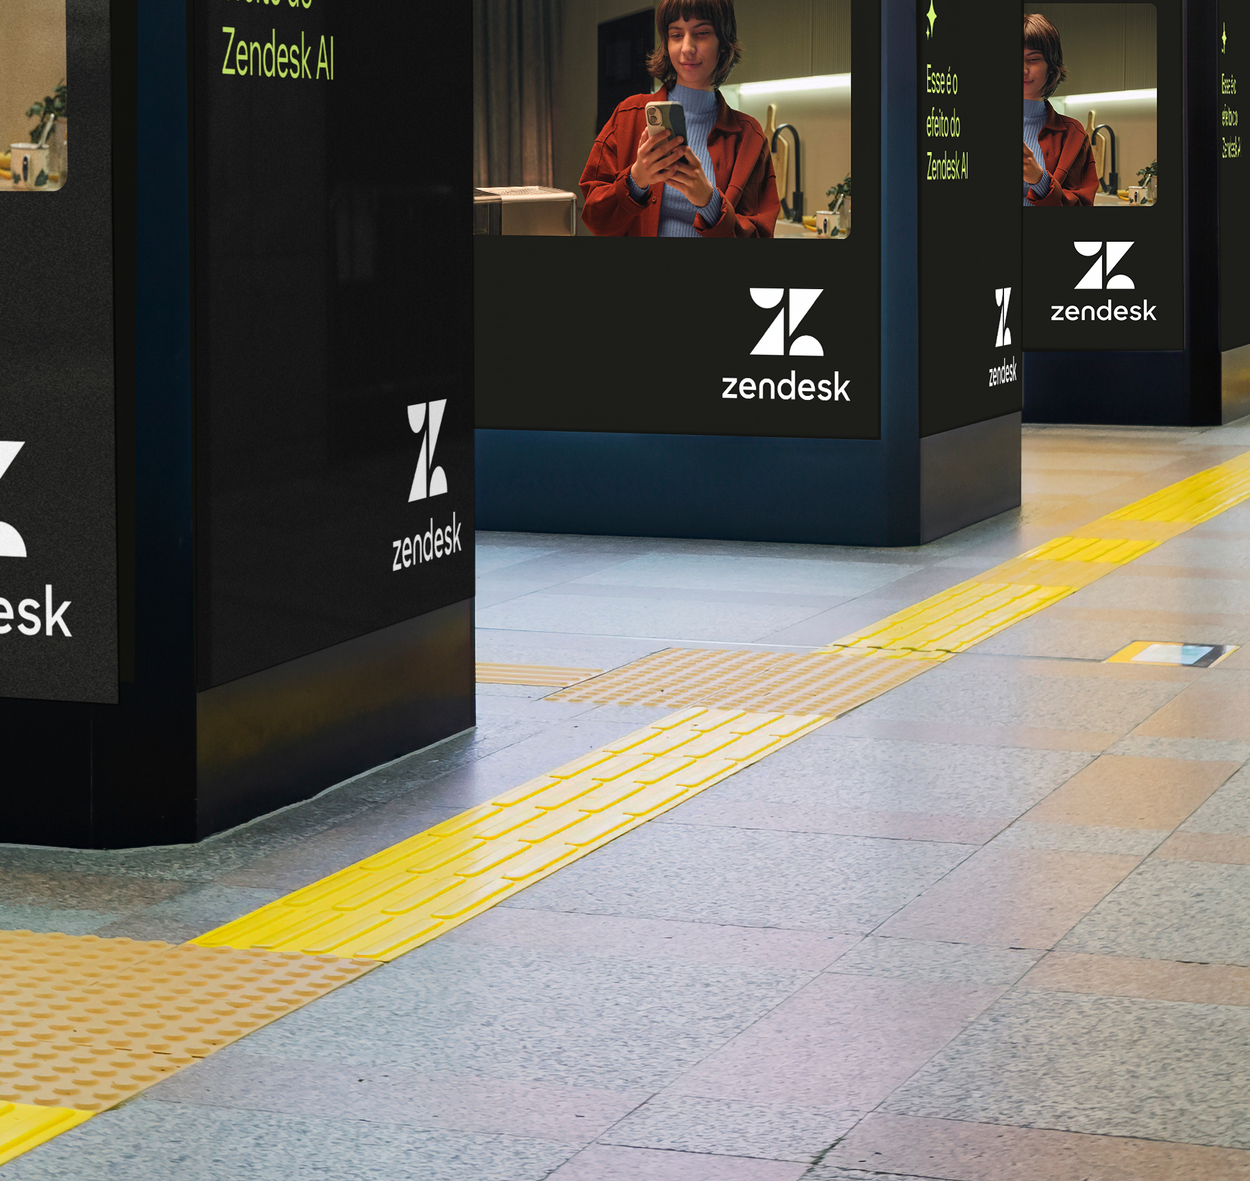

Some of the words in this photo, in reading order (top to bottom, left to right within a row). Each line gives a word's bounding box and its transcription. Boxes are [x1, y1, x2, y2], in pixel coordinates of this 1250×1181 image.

[221, 26, 312, 79] Zendesk
[315, 34, 334, 81] AI
[926, 63, 945, 94] Esse
[946, 66, 952, 95] é
[952, 73, 959, 95] o
[926, 106, 949, 137] efeito
[950, 108, 961, 137] do
[926, 150, 960, 180] Zendesk
[961, 151, 969, 180] AI
[1050, 298, 1157, 322] zendesk
[721, 369, 851, 402] zendesk
[988, 355, 1018, 387] zendesk
[392, 511, 462, 572] zendesk
